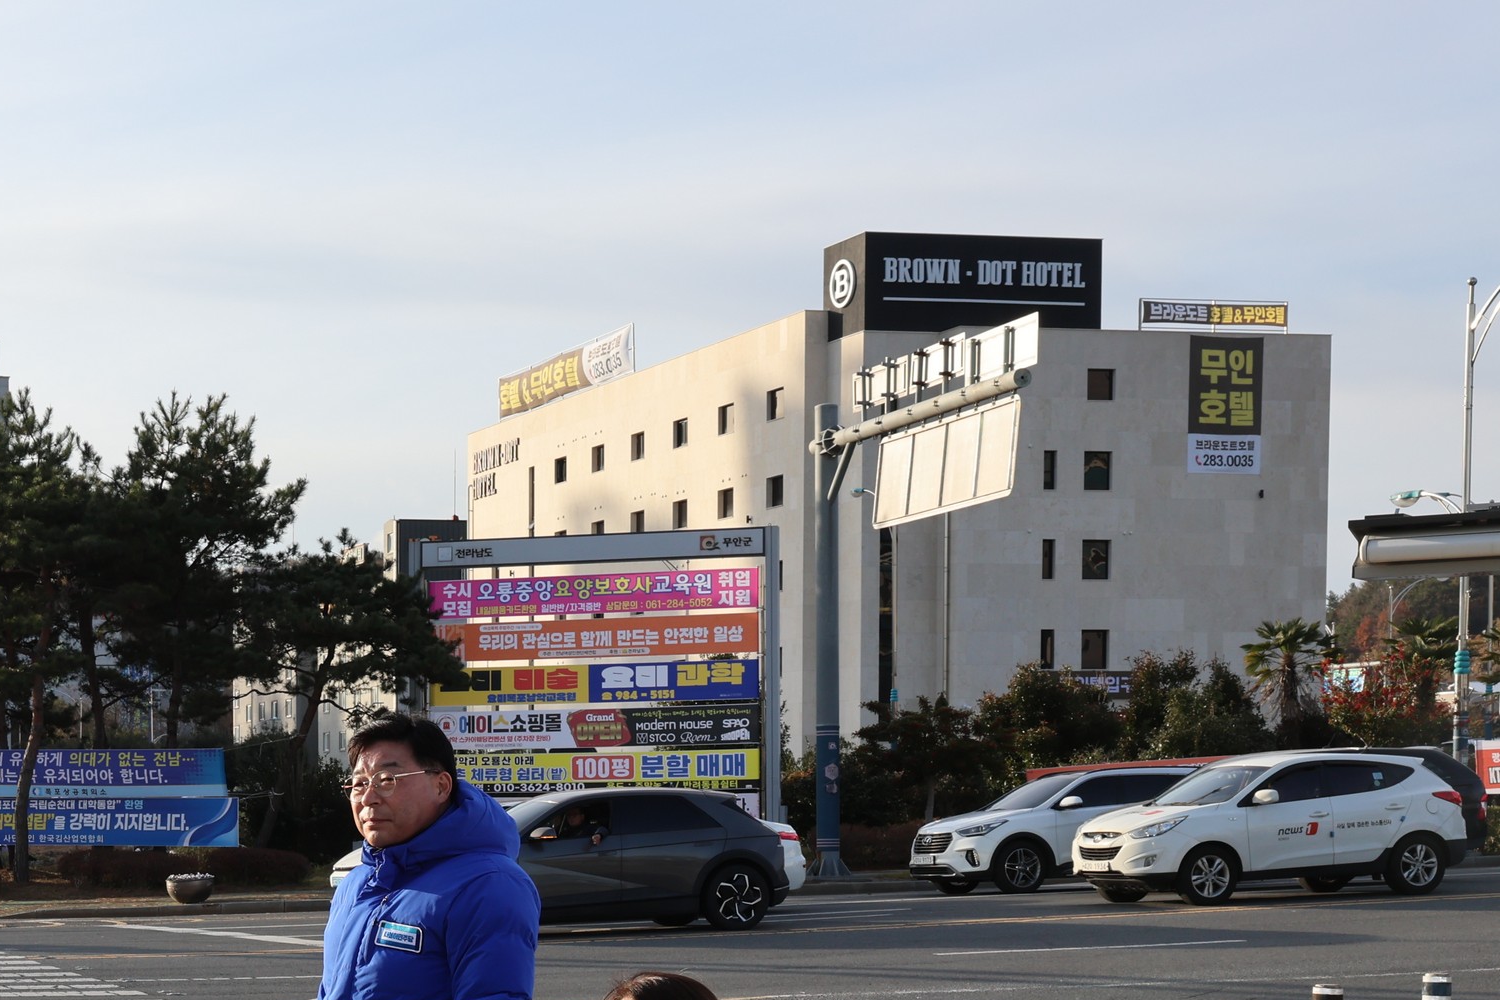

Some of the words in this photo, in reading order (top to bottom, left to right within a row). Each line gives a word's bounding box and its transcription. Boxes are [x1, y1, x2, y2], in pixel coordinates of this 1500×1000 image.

[883, 257, 961, 284] BROWN
[977, 260, 1017, 286] DOT
[1021, 261, 1086, 288] HOTEL
[1150, 303, 1207, 321] 브라운도트
[1200, 349, 1254, 385] 무인
[530, 355, 581, 400] 무인호텔
[1199, 389, 1254, 427] 호텔
[1196, 439, 1255, 451] 브라운도트호텔
[1203, 454, 1254, 467] 283.0035
[722, 536, 753, 547] 무안군
[455, 547, 493, 559] 전라남도
[718, 570, 751, 588] 취업
[443, 583, 472, 599] 수시
[476, 573, 712, 603] 오룡중앙요양보호사교육원
[606, 598, 638, 611] 상담문의
[645, 598, 713, 609] 061-284-5052
[718, 589, 751, 607] 지원
[442, 601, 472, 617] 모집
[479, 634, 518, 650] 우리의
[522, 632, 576, 649] 관심으로
[581, 631, 612, 648] 함께
[617, 629, 659, 646] 만드는
[664, 627, 708, 645] 안전한
[714, 625, 743, 643] 일상
[601, 665, 669, 689] 요미
[677, 662, 746, 687] 과학
[615, 690, 638, 700] 984
[650, 689, 675, 699] 5151
[459, 713, 562, 734] 에이스쇼핑몰
[585, 713, 615, 722] Grand
[722, 717, 750, 728] SPAO
[577, 722, 622, 741] OPEN
[649, 732, 676, 743] STCO
[9, 752, 62, 767] 유하게
[69, 752, 111, 767] 의대가
[118, 752, 146, 767] 없는
[481, 756, 511, 766] 오룡산
[514, 756, 535, 765] 아래
[576, 757, 631, 779] 100평
[641, 754, 691, 779] 분할
[696, 753, 747, 777] 매매
[43, 769, 114, 784] 유치되어야
[120, 769, 168, 784] 합니다.
[471, 767, 512, 782] 체류형
[493, 783, 585, 793] 010-3624-8010
[124, 800, 143, 810] 환영
[70, 814, 110, 831] 강력히
[114, 814, 189, 832] 지지합니다.
[39, 834, 104, 843] 한국김산업연합회
